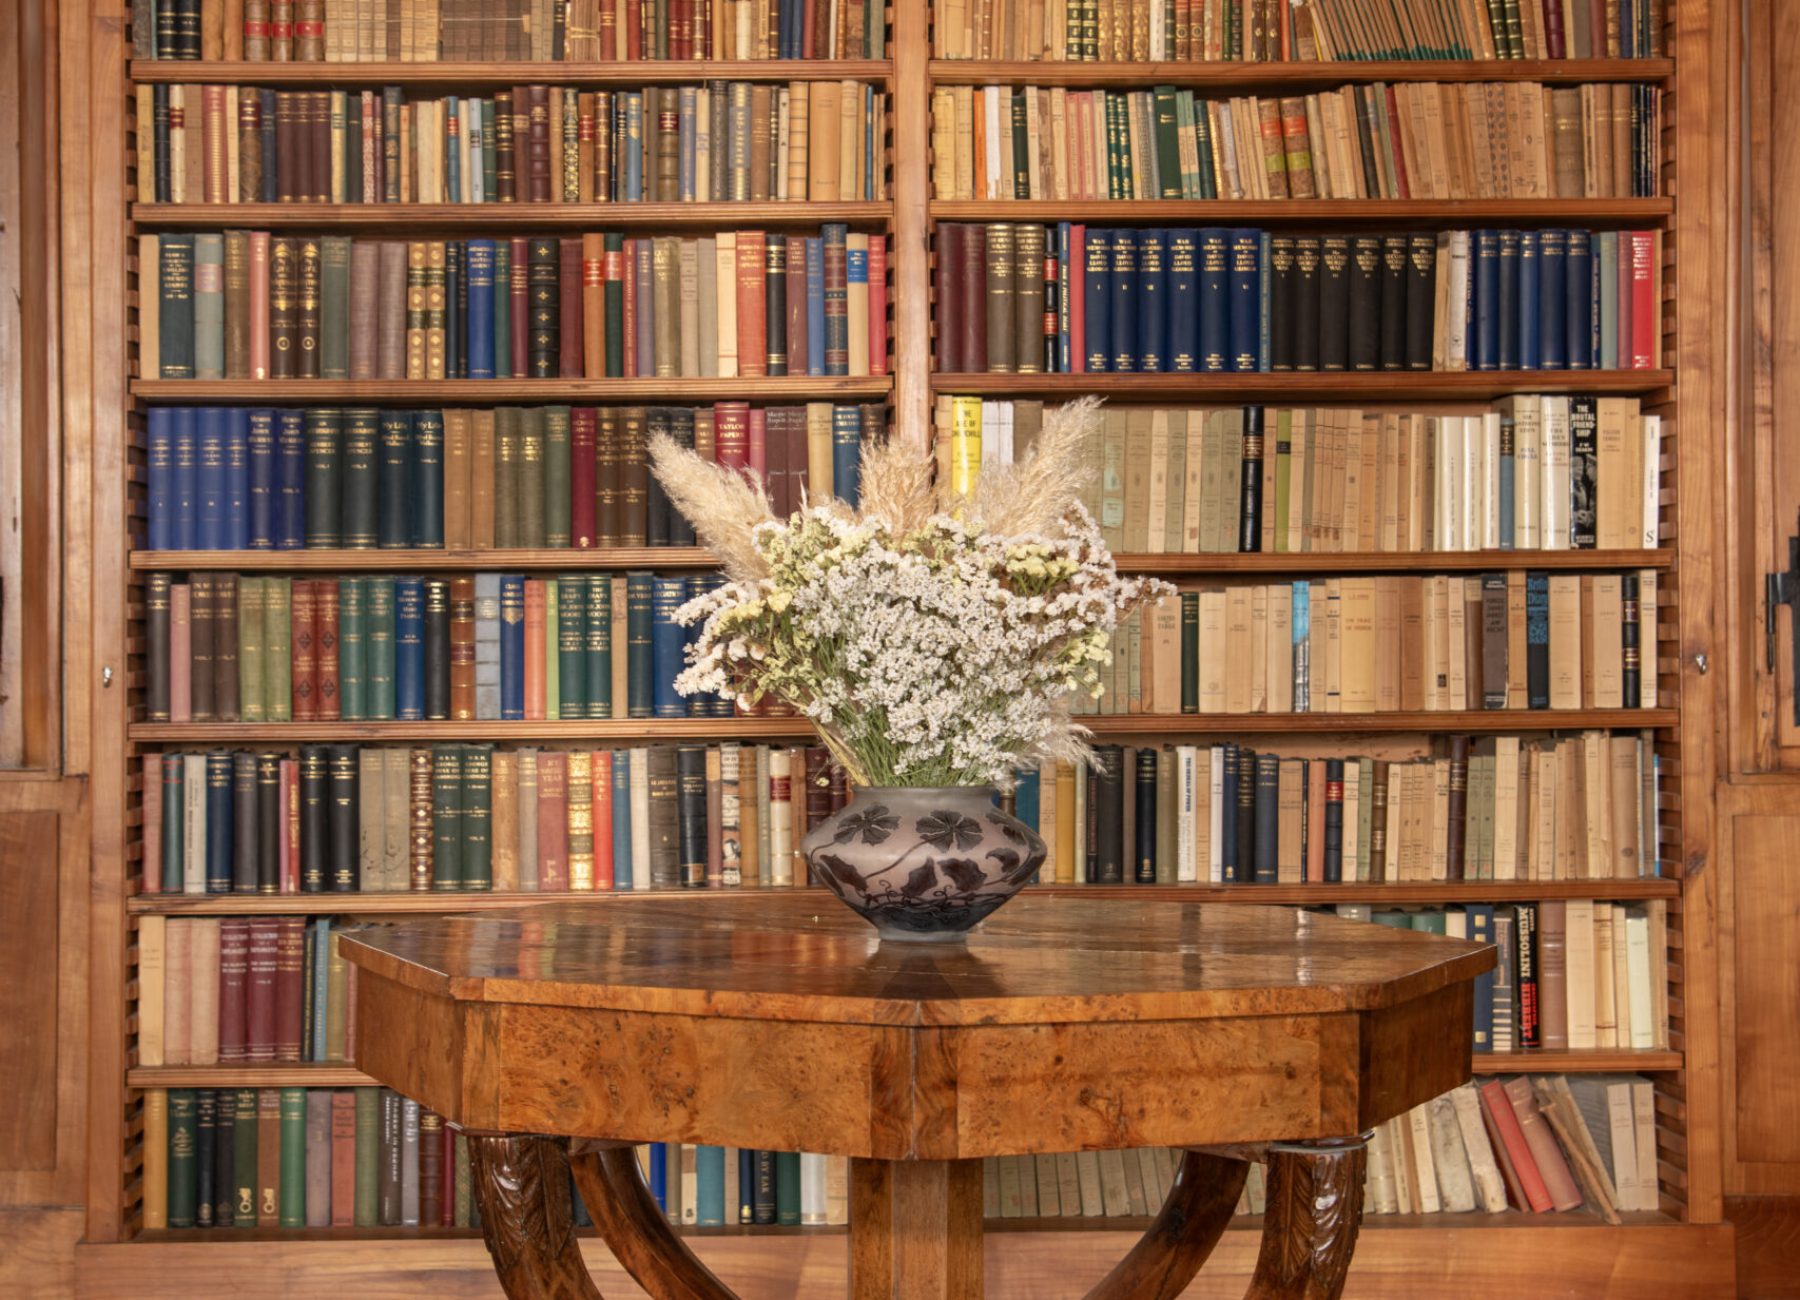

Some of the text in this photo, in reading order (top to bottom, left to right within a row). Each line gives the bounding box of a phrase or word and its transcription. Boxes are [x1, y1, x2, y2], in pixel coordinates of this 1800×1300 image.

[1646, 531, 1654, 543] S
[1519, 908, 1530, 978] MUSSOLINI
[1521, 983, 1532, 1038] HIBBERT
[761, 1162, 769, 1173] BY
[761, 1176, 769, 1193] EAR
